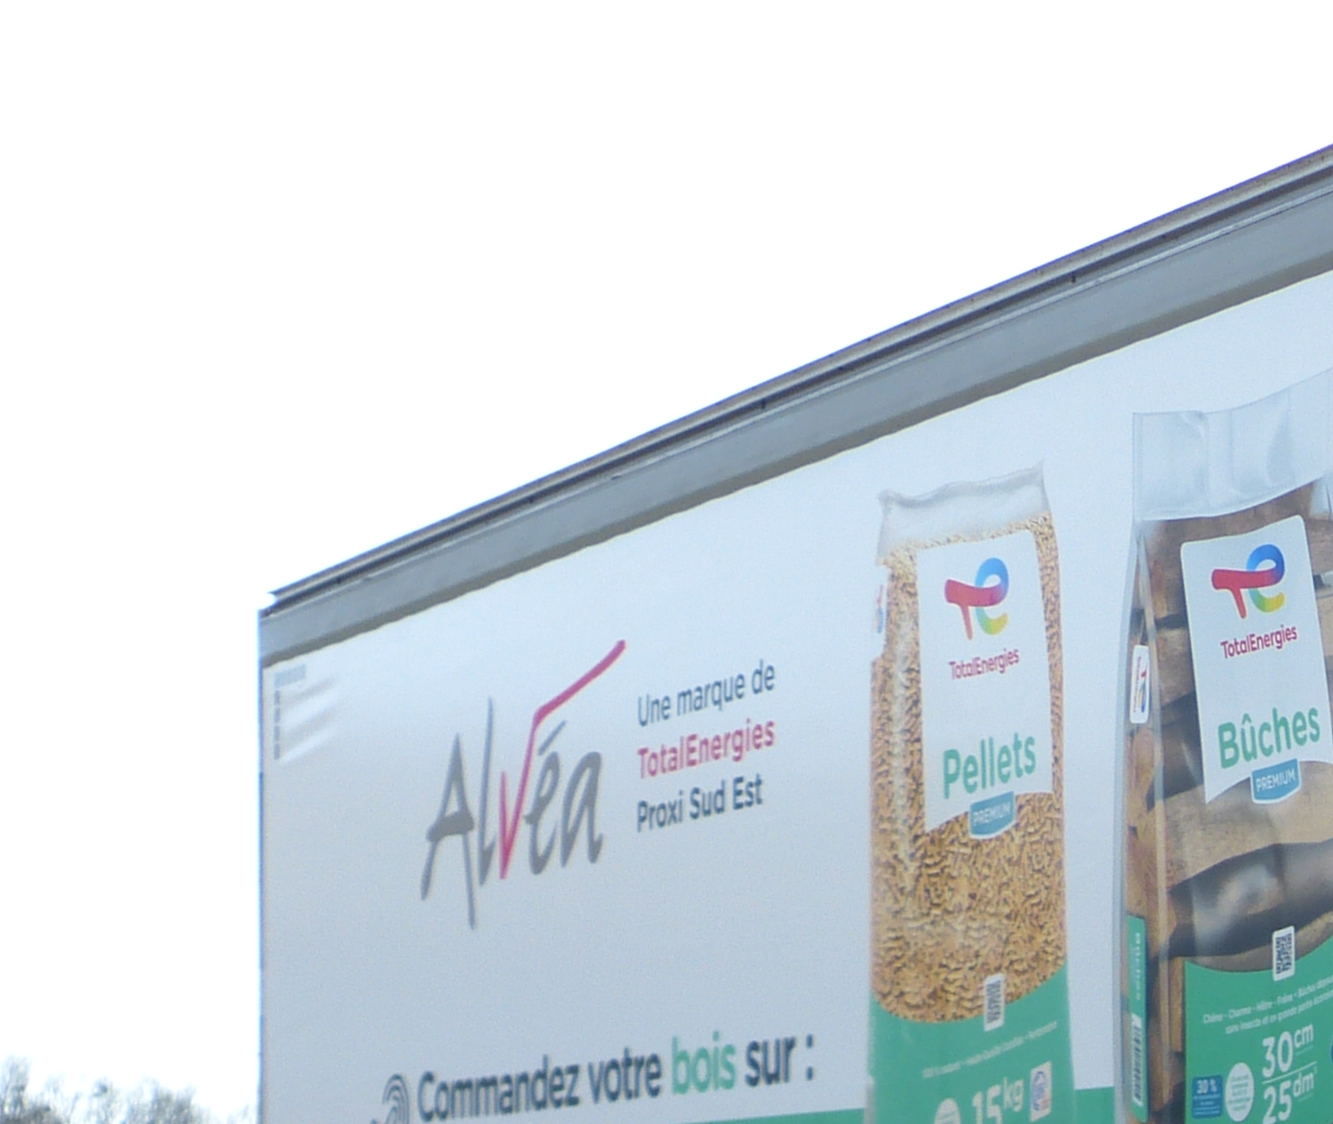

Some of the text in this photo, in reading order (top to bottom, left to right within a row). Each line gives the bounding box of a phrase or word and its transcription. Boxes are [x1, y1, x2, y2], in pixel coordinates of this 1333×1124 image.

[949, 648, 1020, 680] TotalEnergies
[1220, 624, 1298, 659] TotalEnergies
[637, 659, 776, 727] Une marque de
[636, 717, 777, 780] TotalEnergies
[943, 732, 1036, 799] Pellets
[1217, 707, 1321, 770] Bûches
[420, 639, 626, 930] Alvéa
[636, 774, 763, 832] Proxi Sud Est
[1255, 768, 1296, 792] PREMIUM
[972, 801, 1011, 827] PREMIUM
[417, 1054, 579, 1122] Commandez
[588, 1047, 662, 1104] votre
[672, 1031, 736, 1095] bois
[745, 1037, 796, 1088] sur
